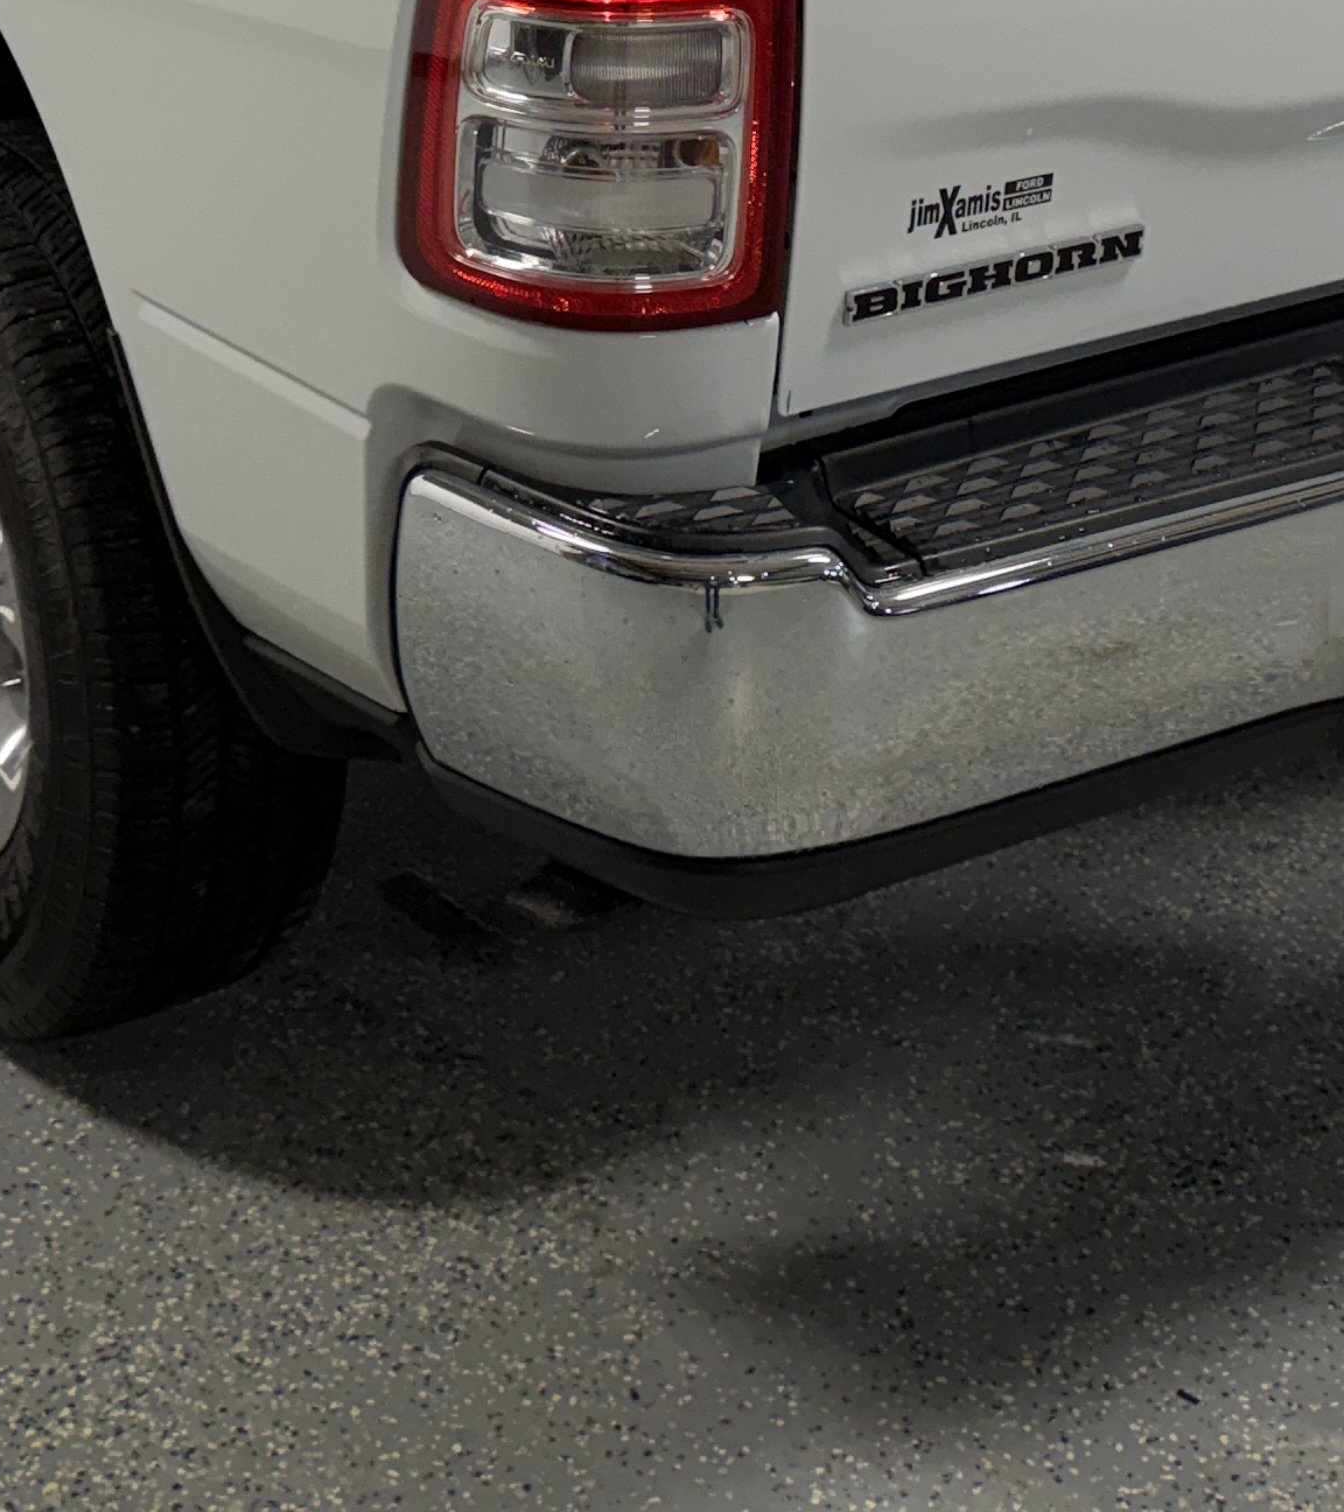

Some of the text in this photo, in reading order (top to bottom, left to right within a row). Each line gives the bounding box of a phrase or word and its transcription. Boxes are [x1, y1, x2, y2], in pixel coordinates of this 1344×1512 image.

[1016, 176, 1044, 191] FORD
[1005, 191, 1051, 209] LINCOLN
[1011, 211, 1022, 223] IL
[849, 226, 1146, 324] BIGHORN
